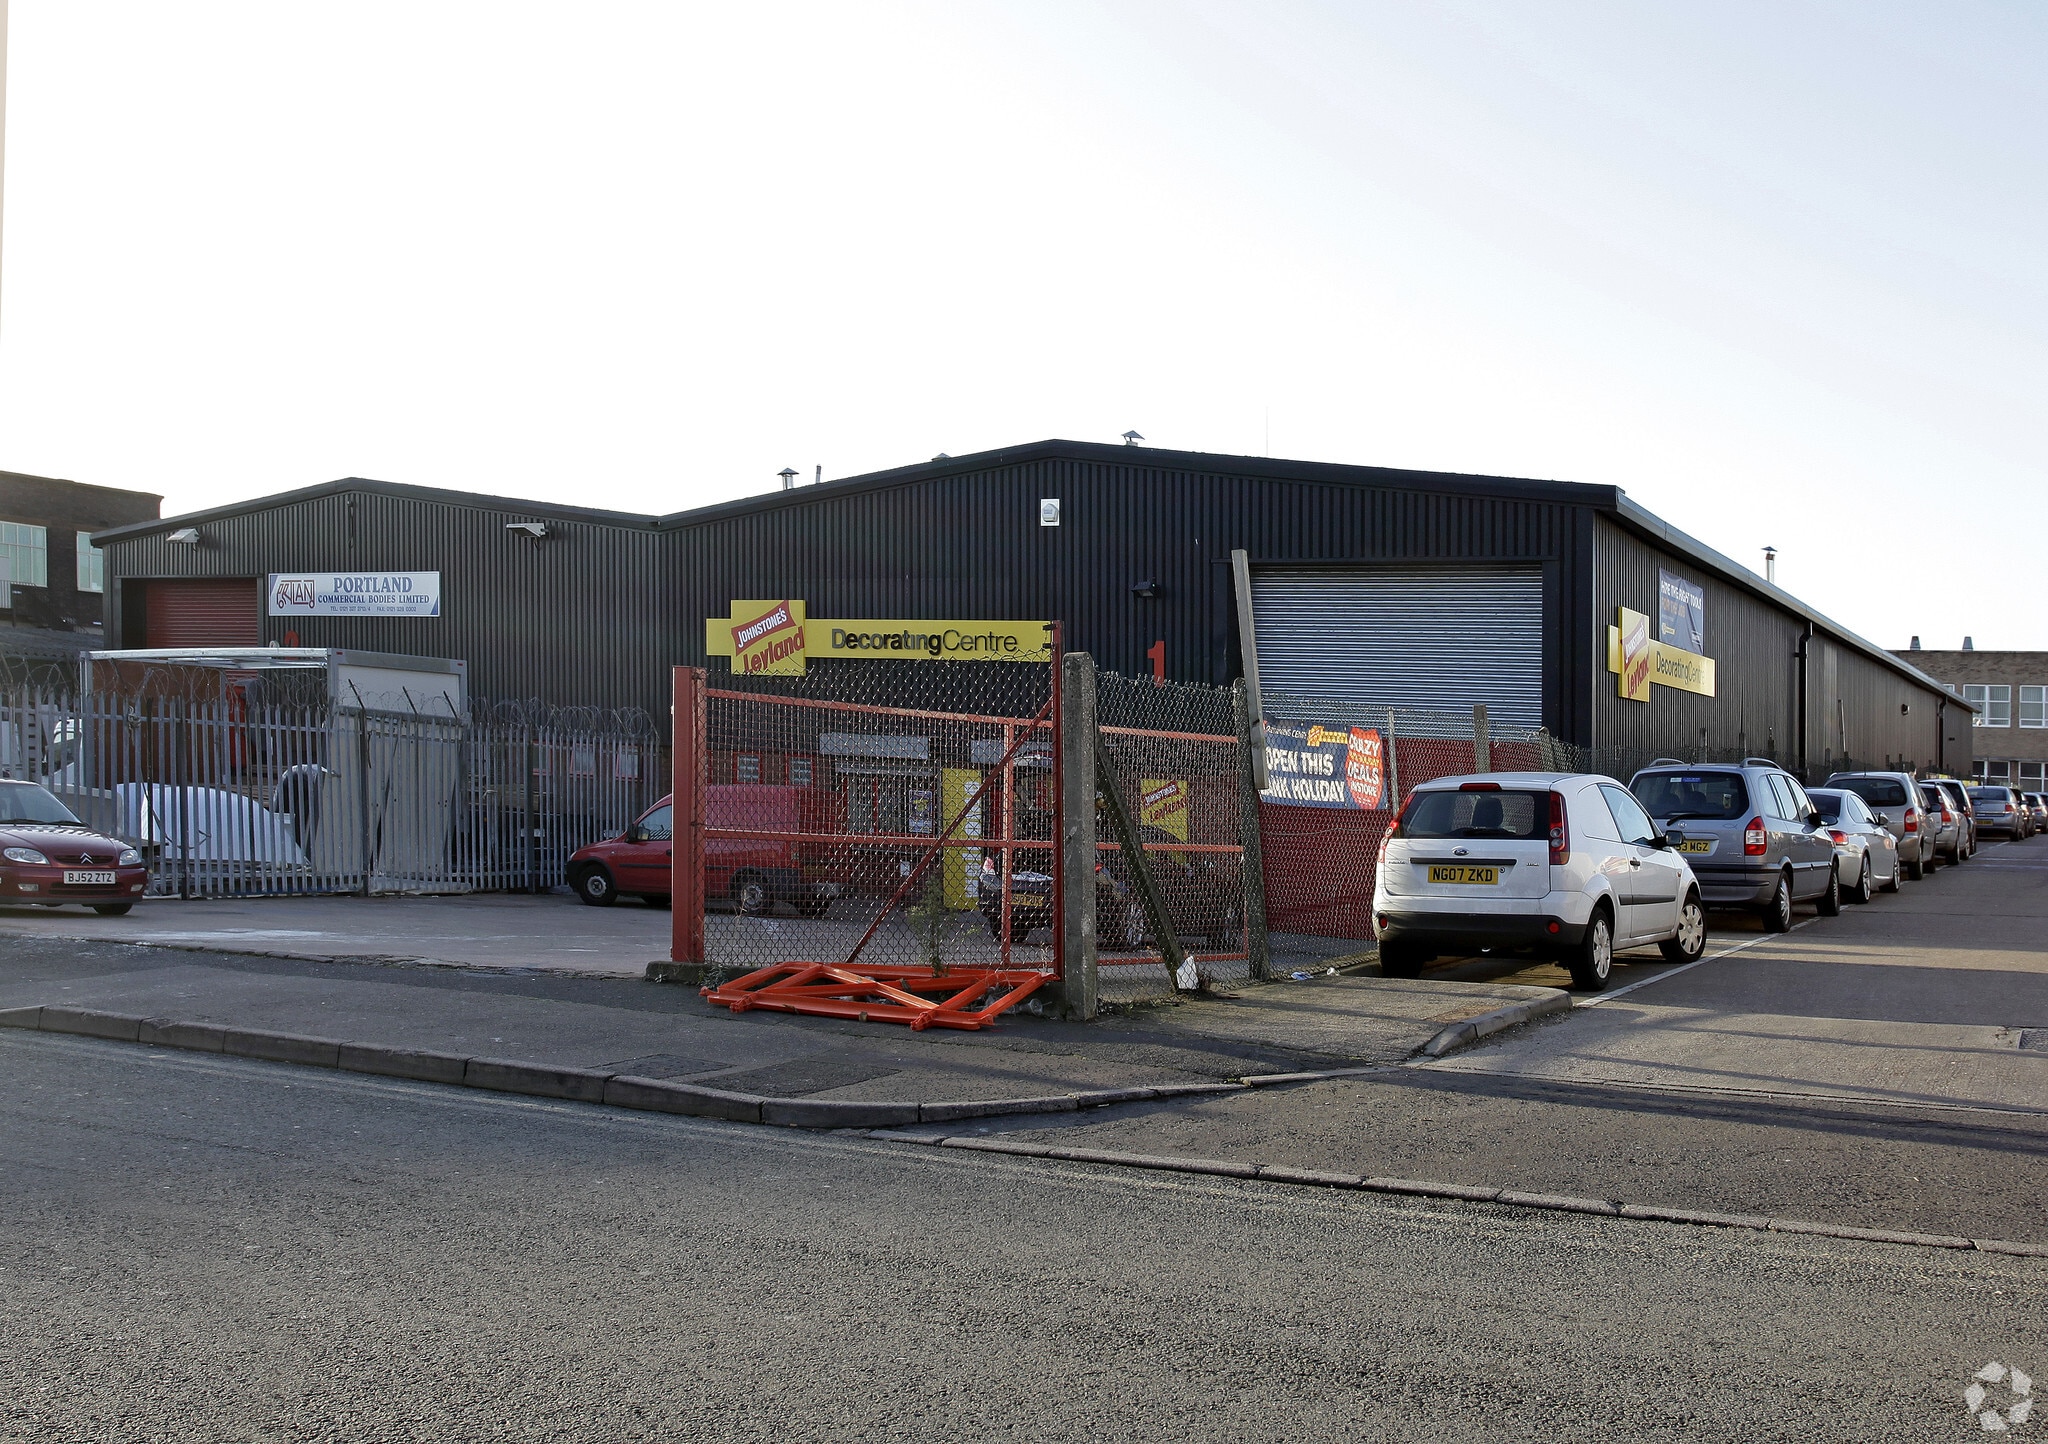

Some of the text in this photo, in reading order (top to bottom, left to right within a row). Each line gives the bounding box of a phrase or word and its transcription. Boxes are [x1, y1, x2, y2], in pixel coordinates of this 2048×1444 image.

[333, 576, 413, 593] PORTLAND
[317, 595, 430, 604] COMMERCIAL BODIES LIMITED
[743, 625, 805, 674] Leyland
[1147, 640, 1165, 688] 1
[1348, 733, 1380, 758] CRAZY
[1265, 746, 1299, 773] OPEN
[1300, 751, 1334, 776] THIS
[1347, 760, 1379, 786] DEALS
[1260, 774, 1292, 799] ANK
[1291, 778, 1345, 802] HOLIDAY
[1689, 842, 1709, 851] MGZ
[68, 872, 112, 882] BJ52 ZTZ
[1432, 867, 1493, 882] NG07 ZKD
